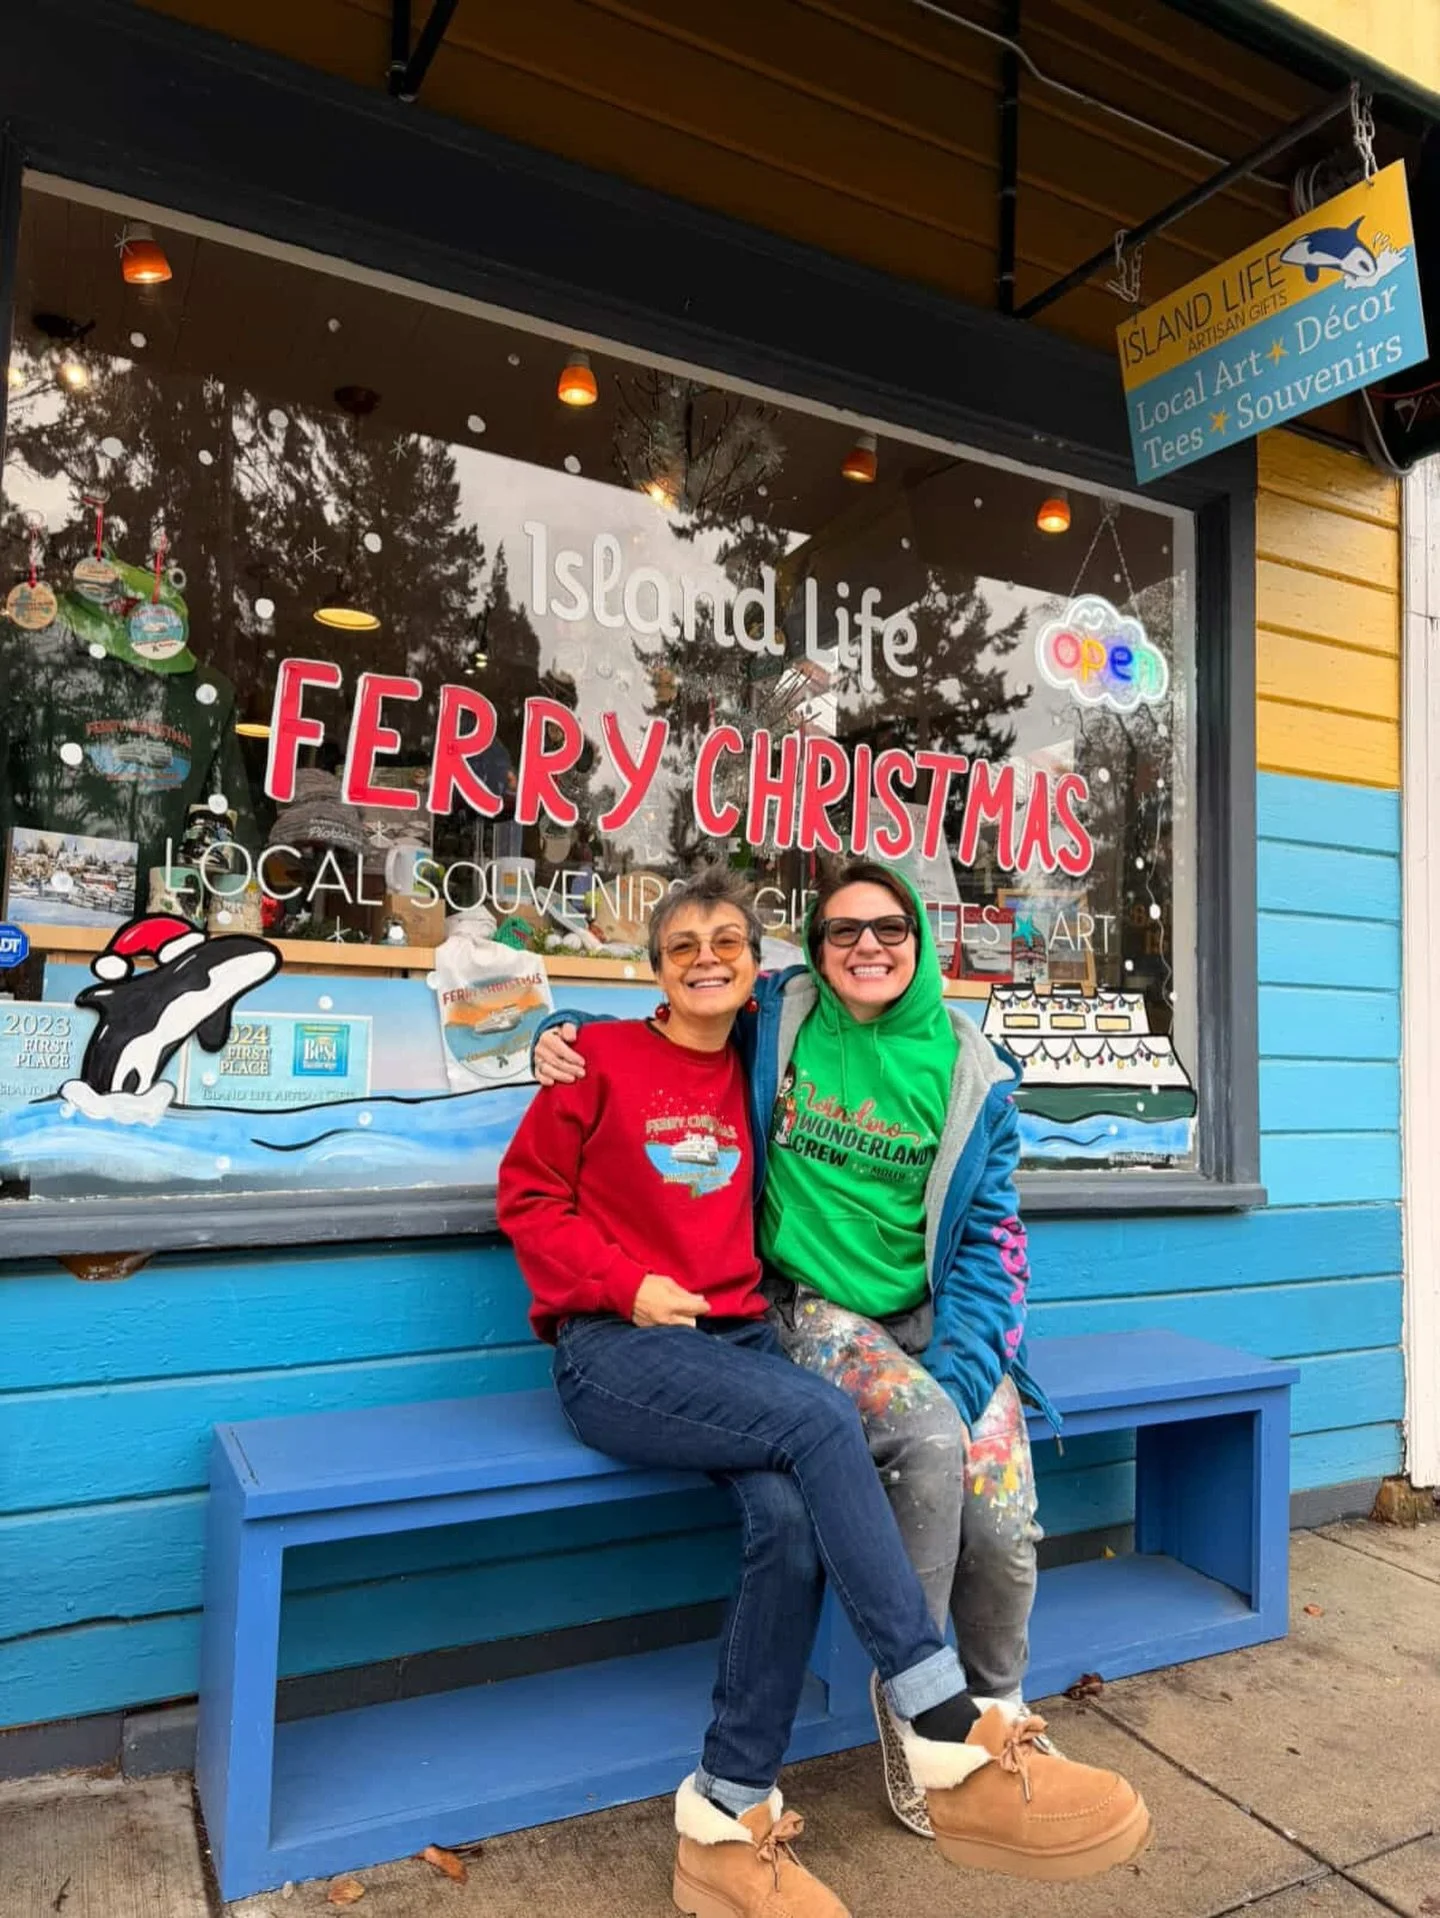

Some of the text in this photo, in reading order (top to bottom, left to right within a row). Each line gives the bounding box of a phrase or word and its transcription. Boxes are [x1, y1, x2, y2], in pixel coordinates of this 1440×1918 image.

[1123, 248, 1285, 368] ISLAND LIFE
[1188, 290, 1288, 354] ARTISAN GIFTS
[1136, 284, 1398, 433] Local Art Décor
[1144, 335, 1403, 469] Tees Souvenirs
[524, 520, 918, 692] Island Life
[265, 658, 1094, 877] FERRY CHRISTMAS
[165, 838, 383, 906] LOCAL
[1049, 911, 1116, 955] ART
[0, 937, 21, 953] DT
[3, 1012, 72, 1037] 2023
[228, 1024, 270, 1045] 024
[16, 1054, 70, 1069] PLACE
[24, 1039, 73, 1054] FIRST
[220, 1060, 270, 1076] PLACE
[227, 1047, 272, 1062] FIRST
[793, 1135, 848, 1167] CREW
[799, 1112, 928, 1166] WONDERLAND
